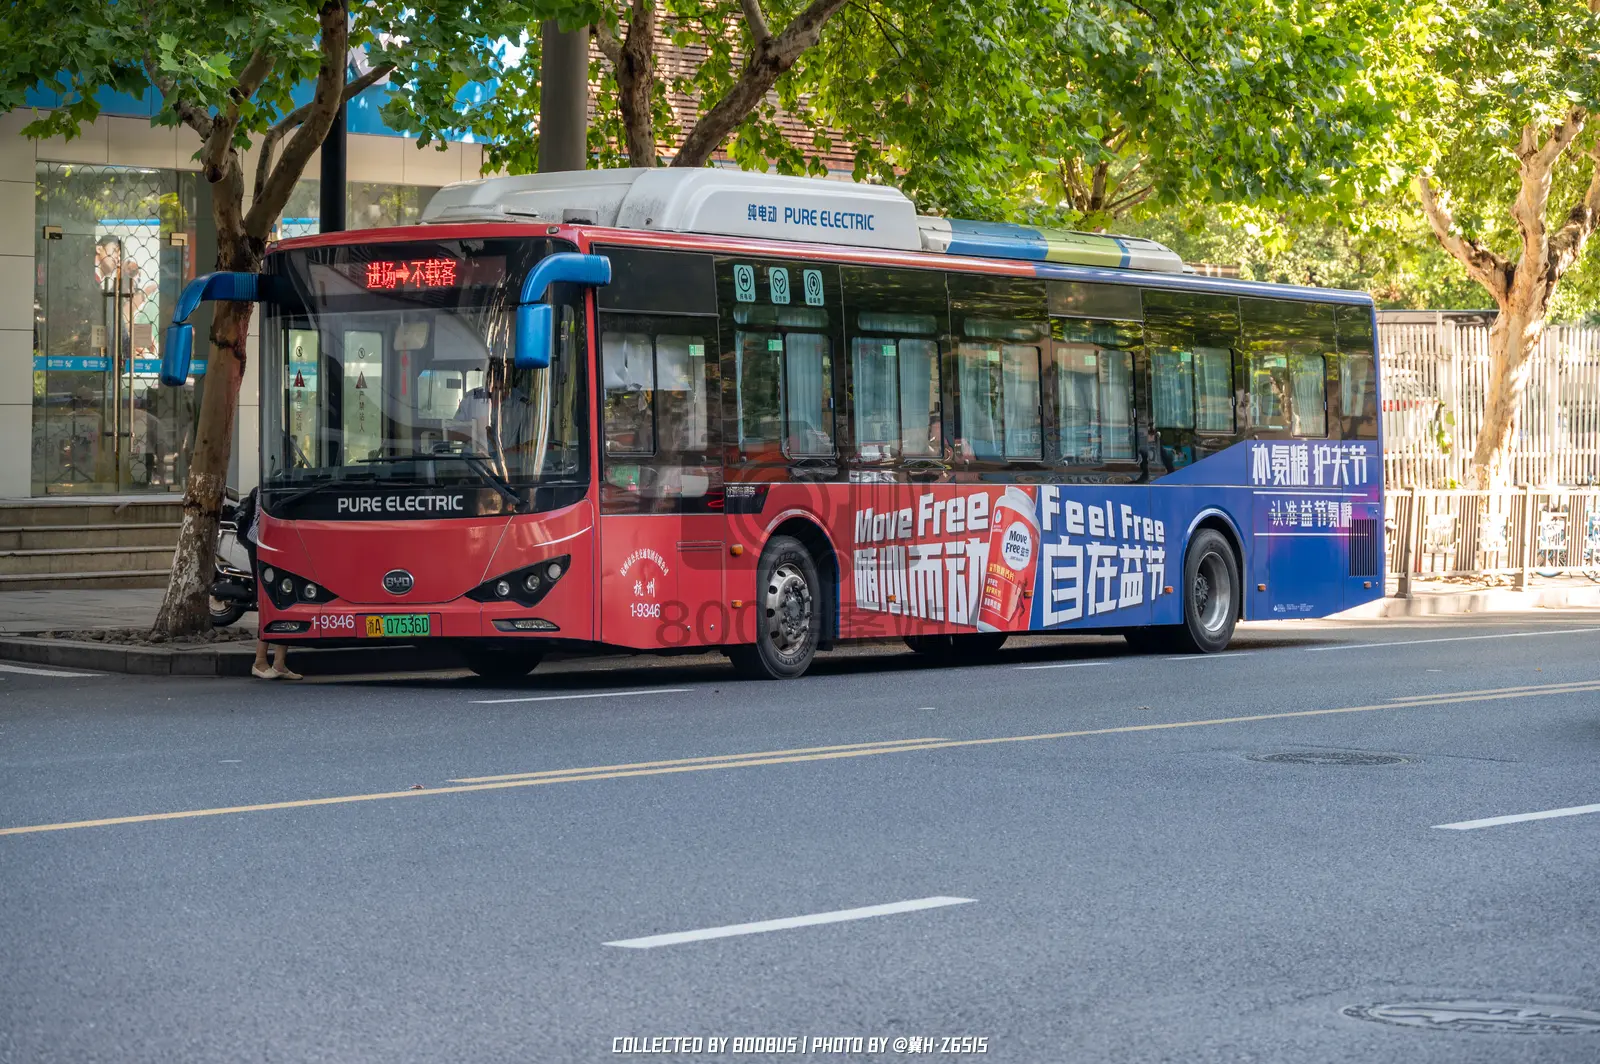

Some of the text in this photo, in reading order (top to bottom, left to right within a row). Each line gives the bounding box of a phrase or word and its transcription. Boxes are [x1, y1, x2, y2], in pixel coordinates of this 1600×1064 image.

[748, 203, 778, 223] 纯电动
[784, 206, 875, 231] PURE ELECTRIC
[365, 258, 457, 289] 进场 不载客
[1313, 443, 1367, 485] 护关节
[338, 495, 463, 513] PURE ELECTRIC
[1041, 485, 1165, 543] Feel Free
[854, 491, 989, 544] Move Free
[1009, 530, 1028, 545] Move
[1005, 542, 1021, 554] Free
[385, 577, 410, 587] BYD
[633, 577, 656, 598] 杭州
[1042, 535, 1166, 627] 自在益节
[630, 602, 661, 618] 1-9346
[311, 614, 355, 630] 1-9346
